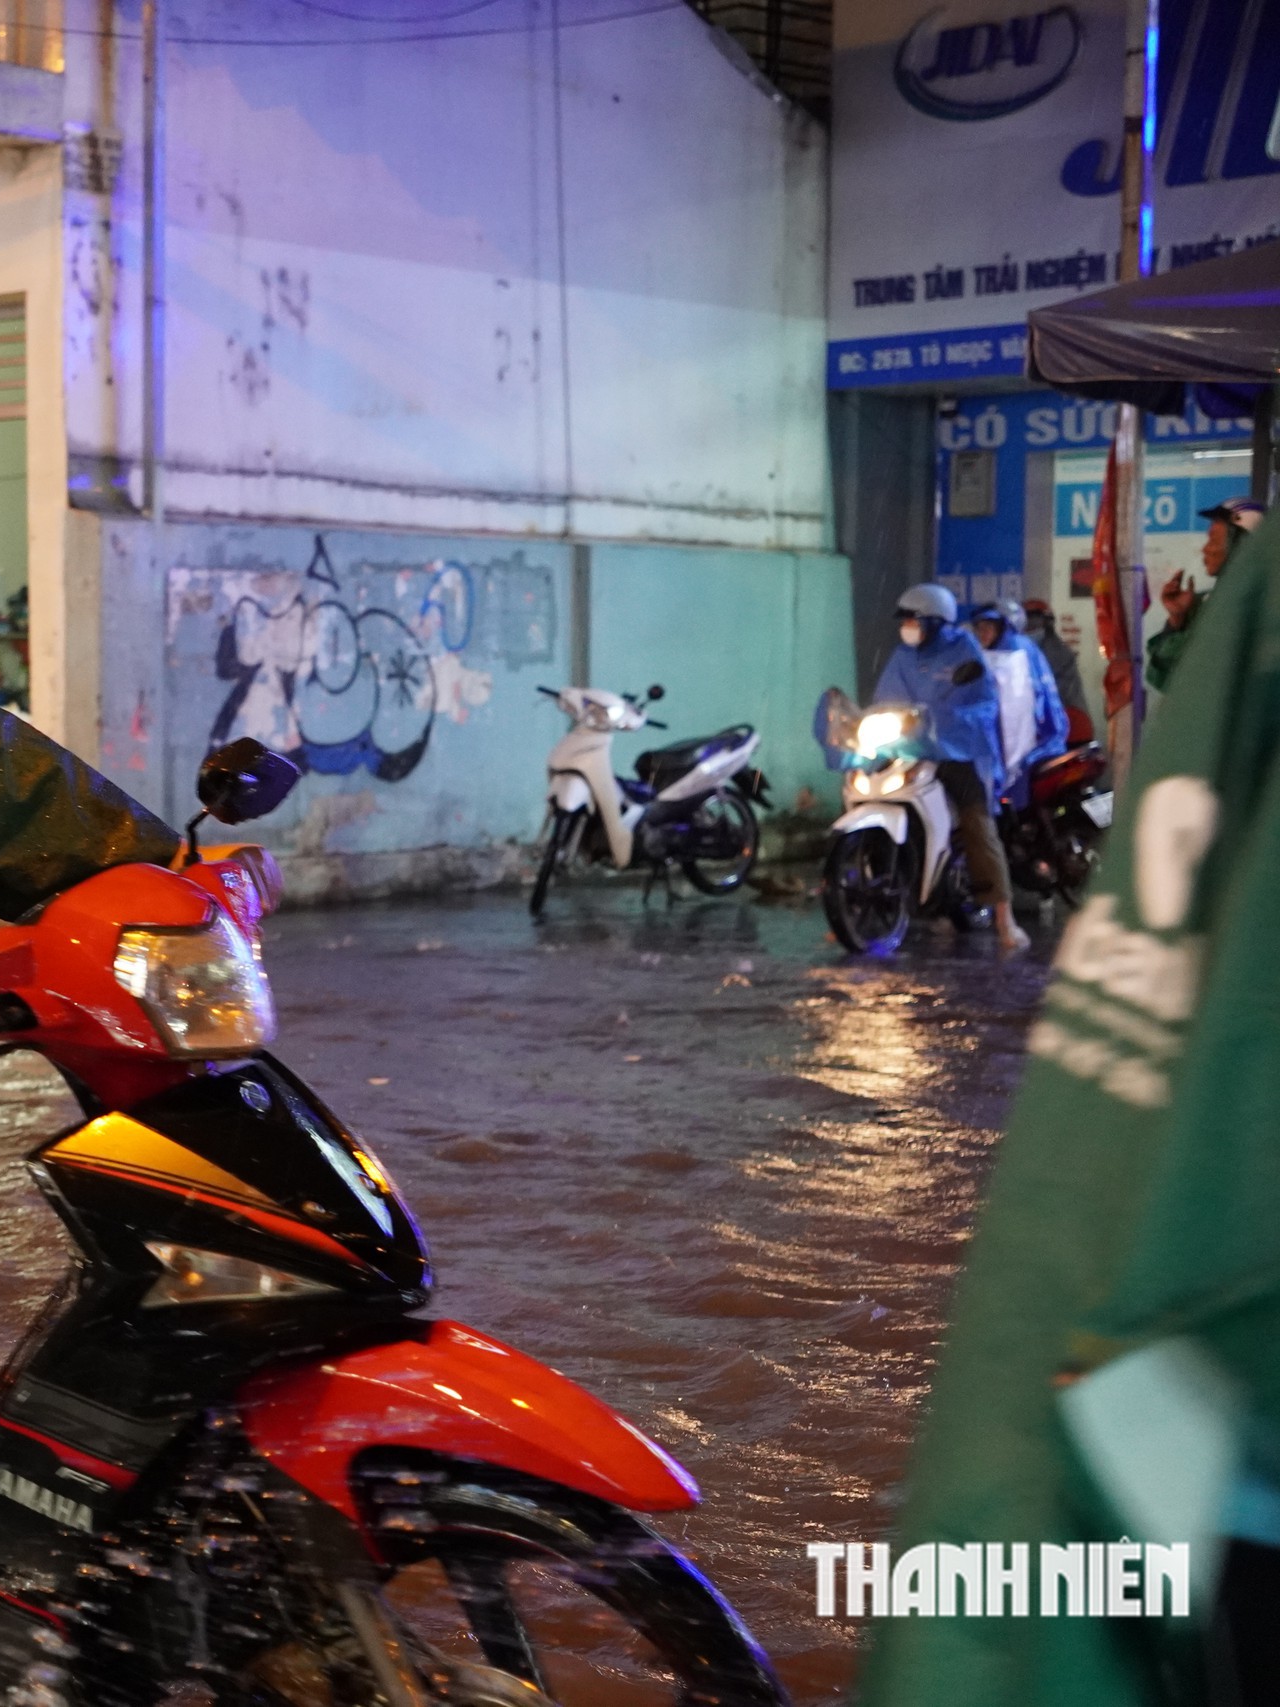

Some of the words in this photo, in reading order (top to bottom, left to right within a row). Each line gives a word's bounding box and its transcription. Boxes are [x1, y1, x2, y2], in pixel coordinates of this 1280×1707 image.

[853, 274, 916, 308] TRUNG
[923, 264, 964, 301] TÂM
[974, 252, 1018, 295] TRẢI
[1025, 248, 1107, 291] NGHIỆM
[938, 404, 1008, 449] CÓ
